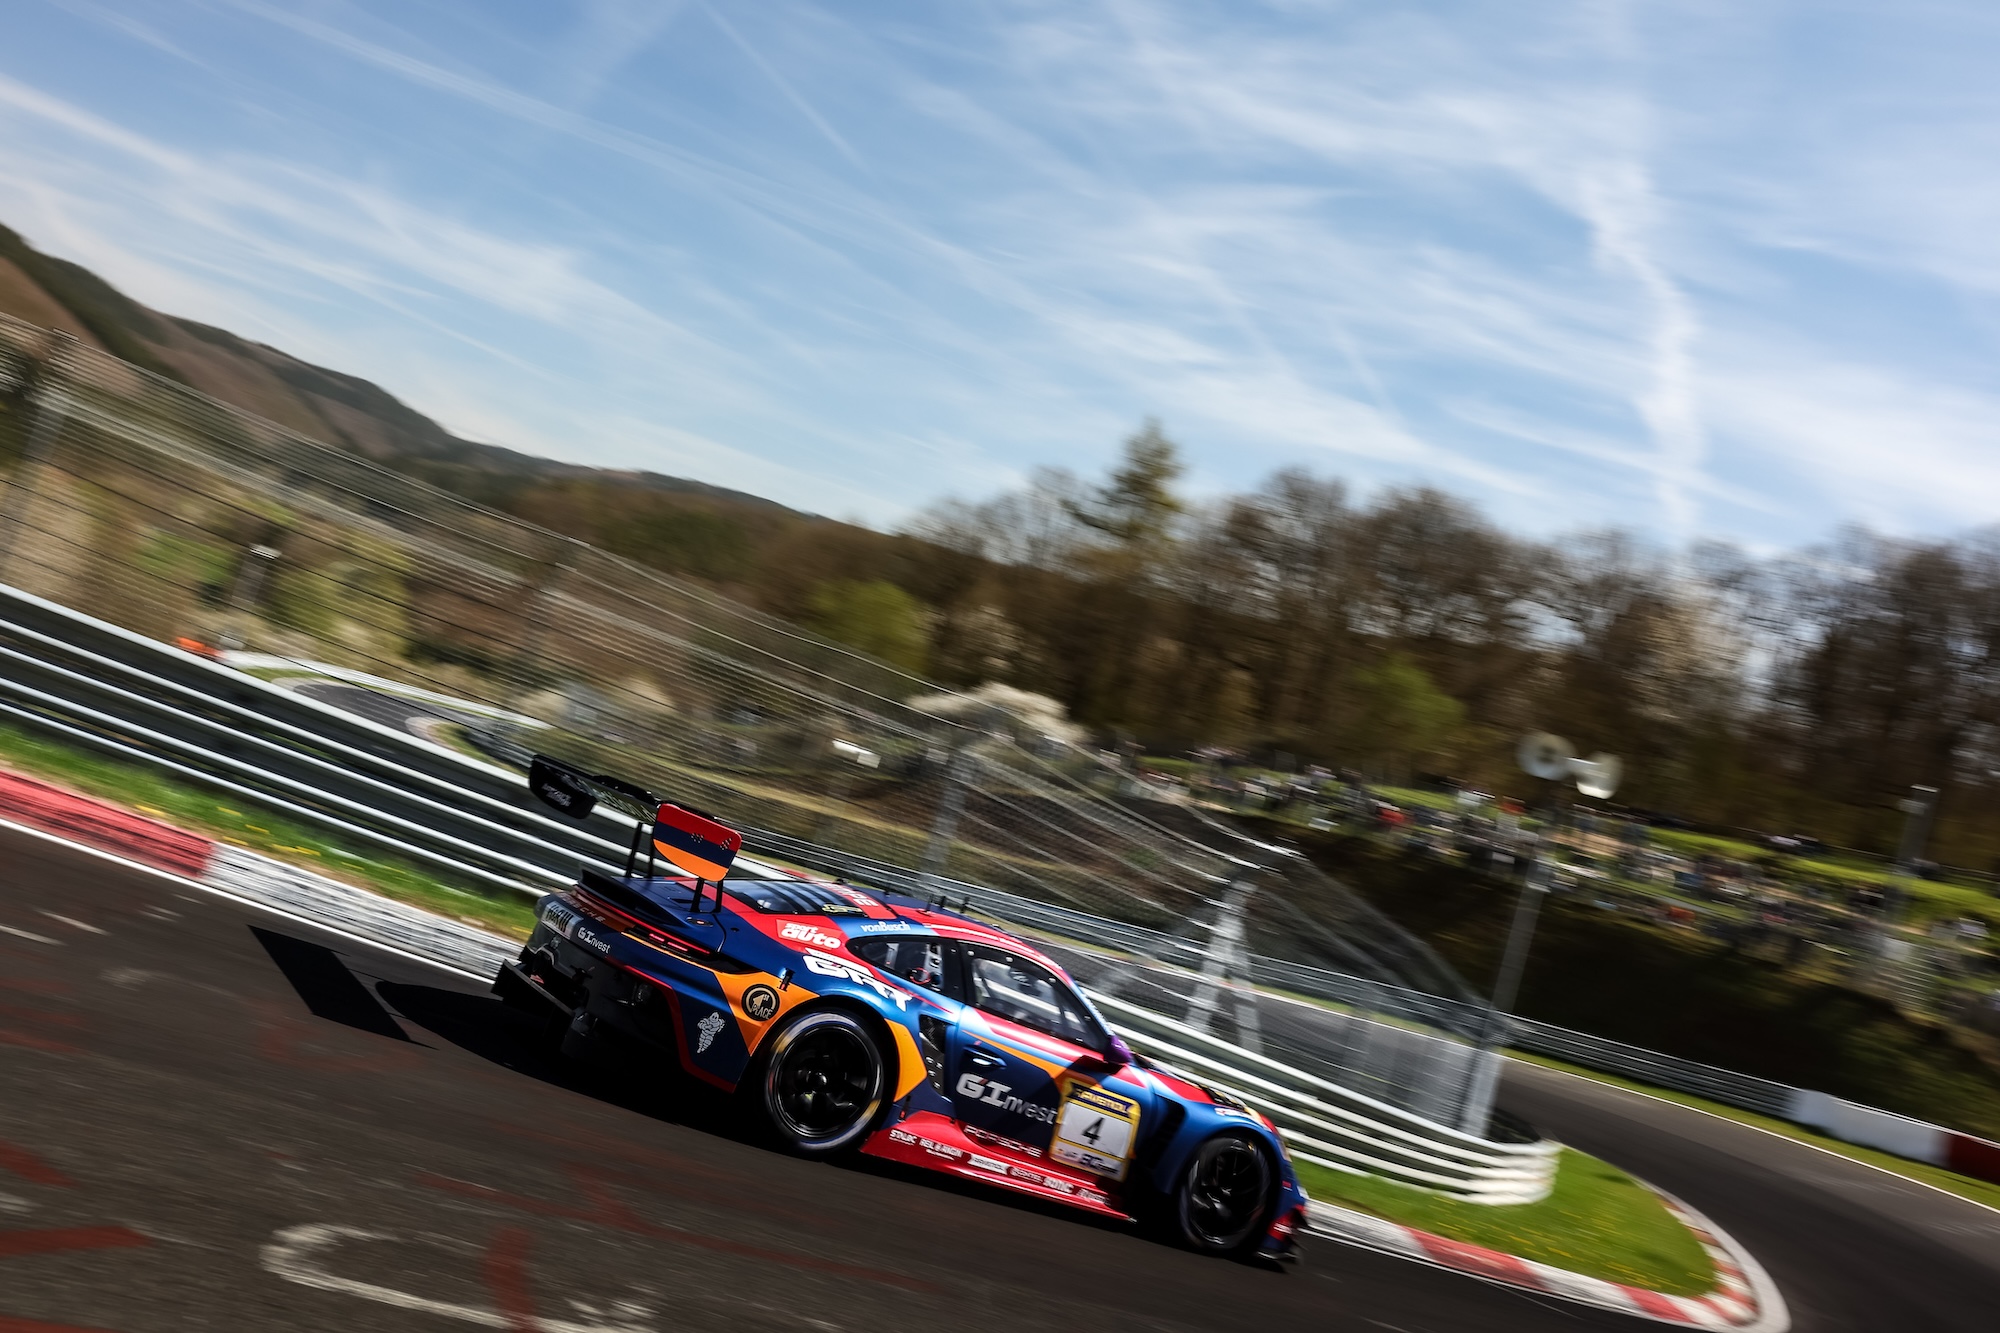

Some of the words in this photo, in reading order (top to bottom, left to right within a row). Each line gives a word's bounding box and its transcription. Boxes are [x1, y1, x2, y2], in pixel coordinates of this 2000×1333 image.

[784, 922, 819, 934] sport
[861, 921, 912, 933] vonBusch
[577, 926, 611, 953] GInvest
[781, 929, 841, 949] auto
[956, 1073, 1059, 1124] GInvest
[1081, 1117, 1105, 1146] 4
